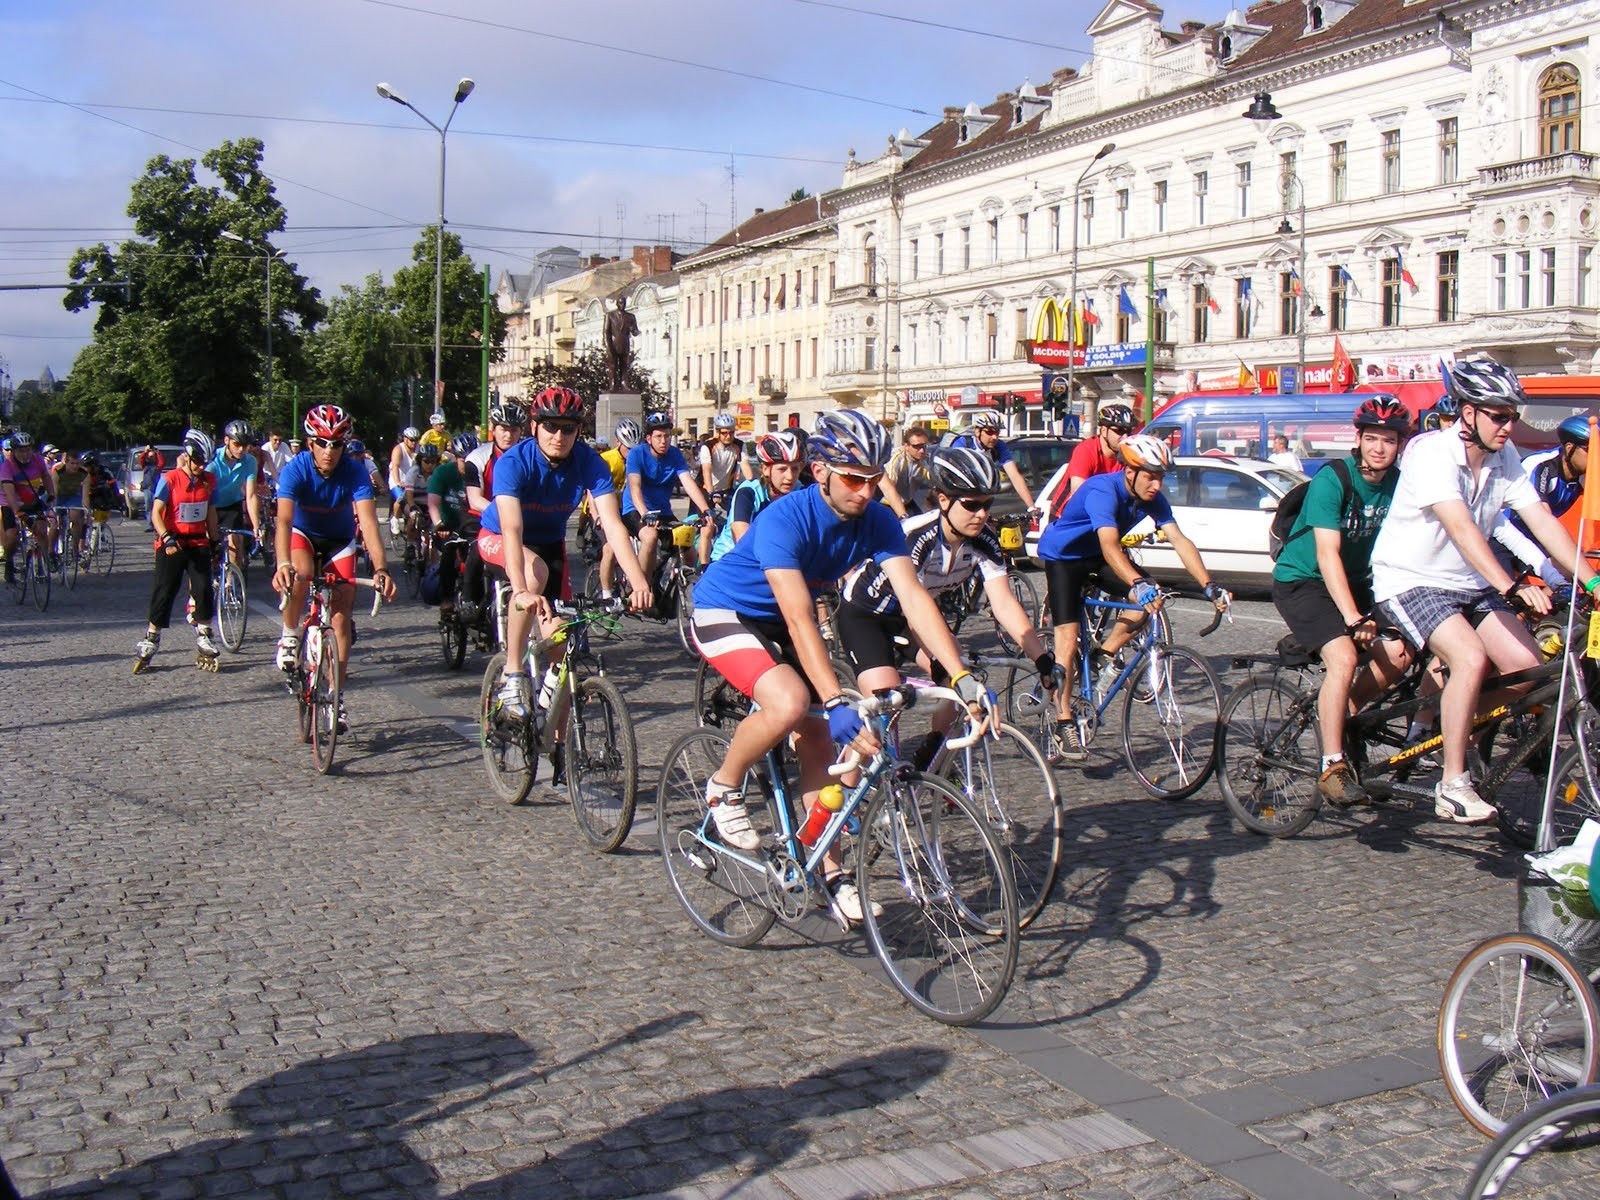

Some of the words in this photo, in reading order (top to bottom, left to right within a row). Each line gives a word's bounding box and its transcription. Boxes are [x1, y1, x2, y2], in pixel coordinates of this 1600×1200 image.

[1123, 342, 1147, 350] VEST
[1033, 347, 1085, 358] McDonad's
[908, 388, 945, 402] Bancpost
[1534, 418, 1560, 431] otpba
